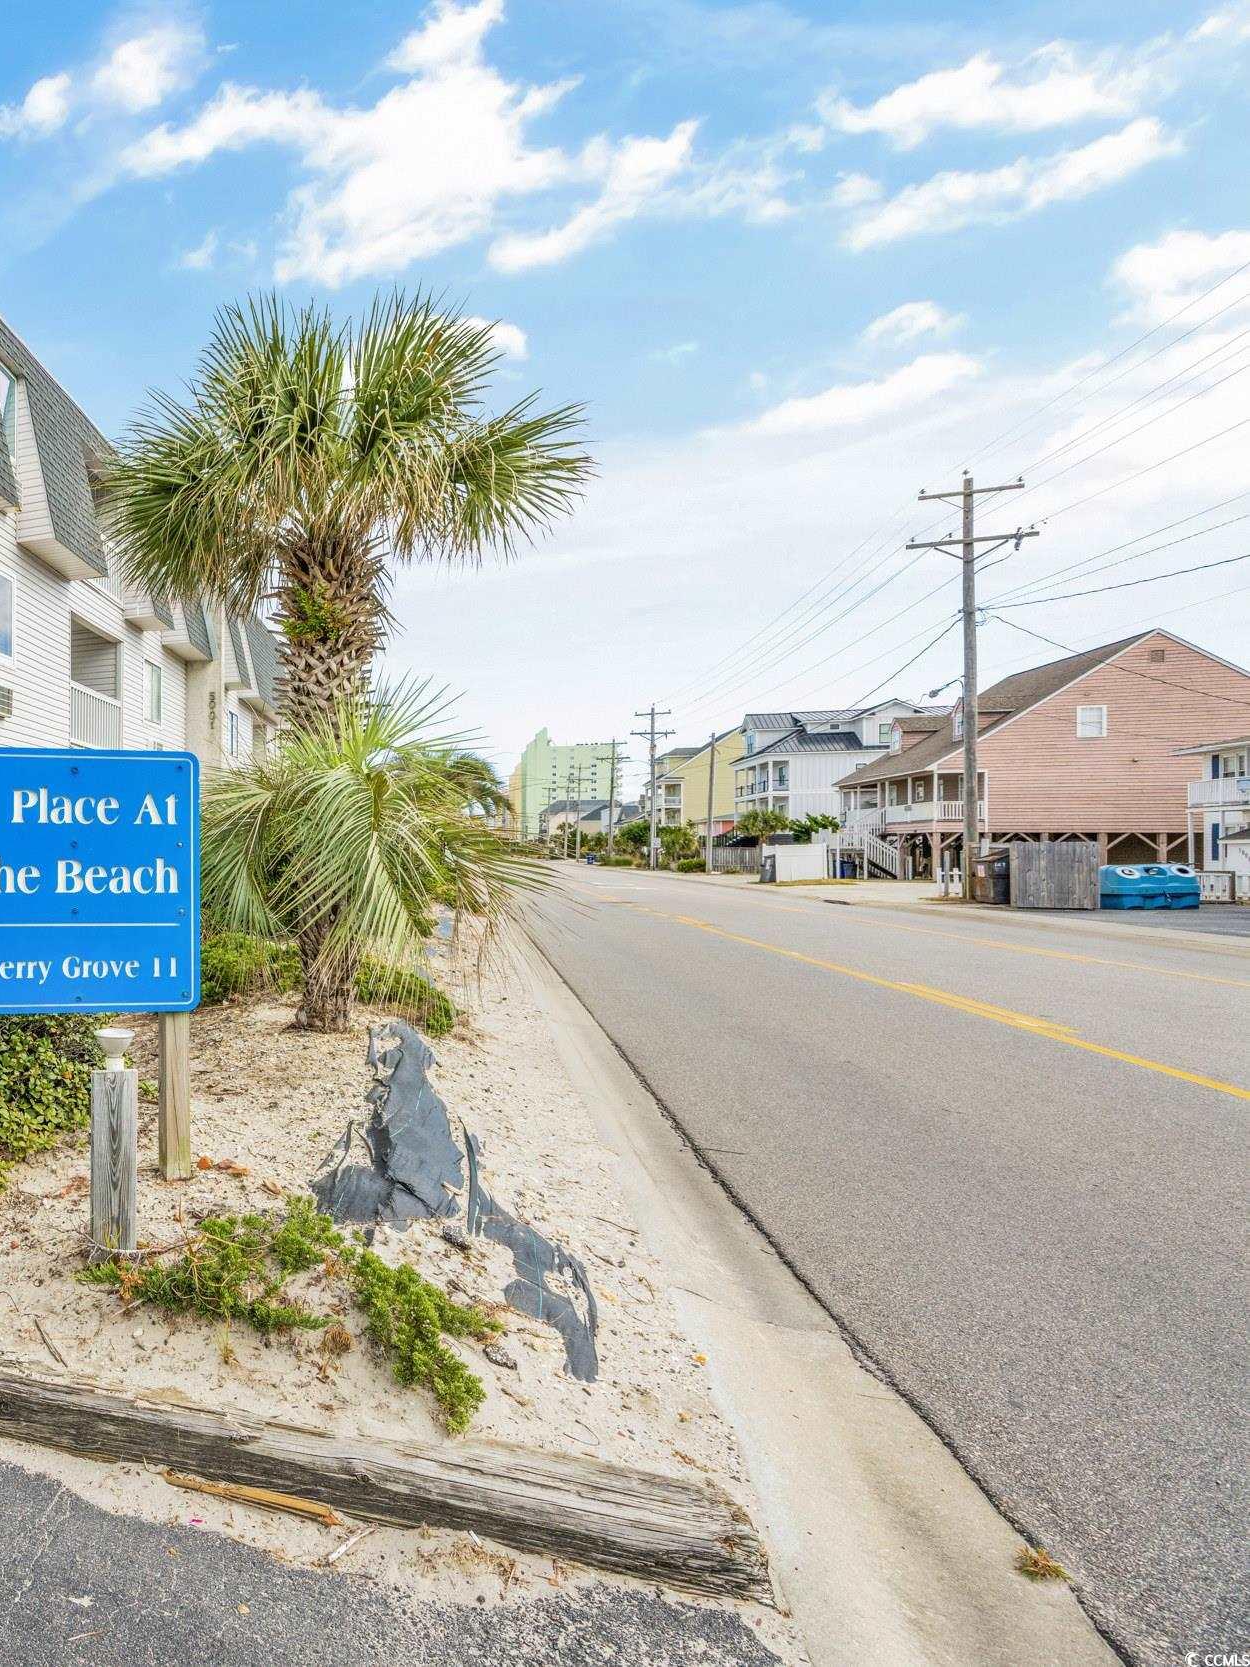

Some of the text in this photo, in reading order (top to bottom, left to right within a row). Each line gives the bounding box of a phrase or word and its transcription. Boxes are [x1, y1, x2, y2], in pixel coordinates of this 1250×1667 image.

[11, 787, 120, 825] Place
[133, 793, 179, 825] At
[54, 858, 179, 894] Beach
[61, 956, 140, 979] Grove
